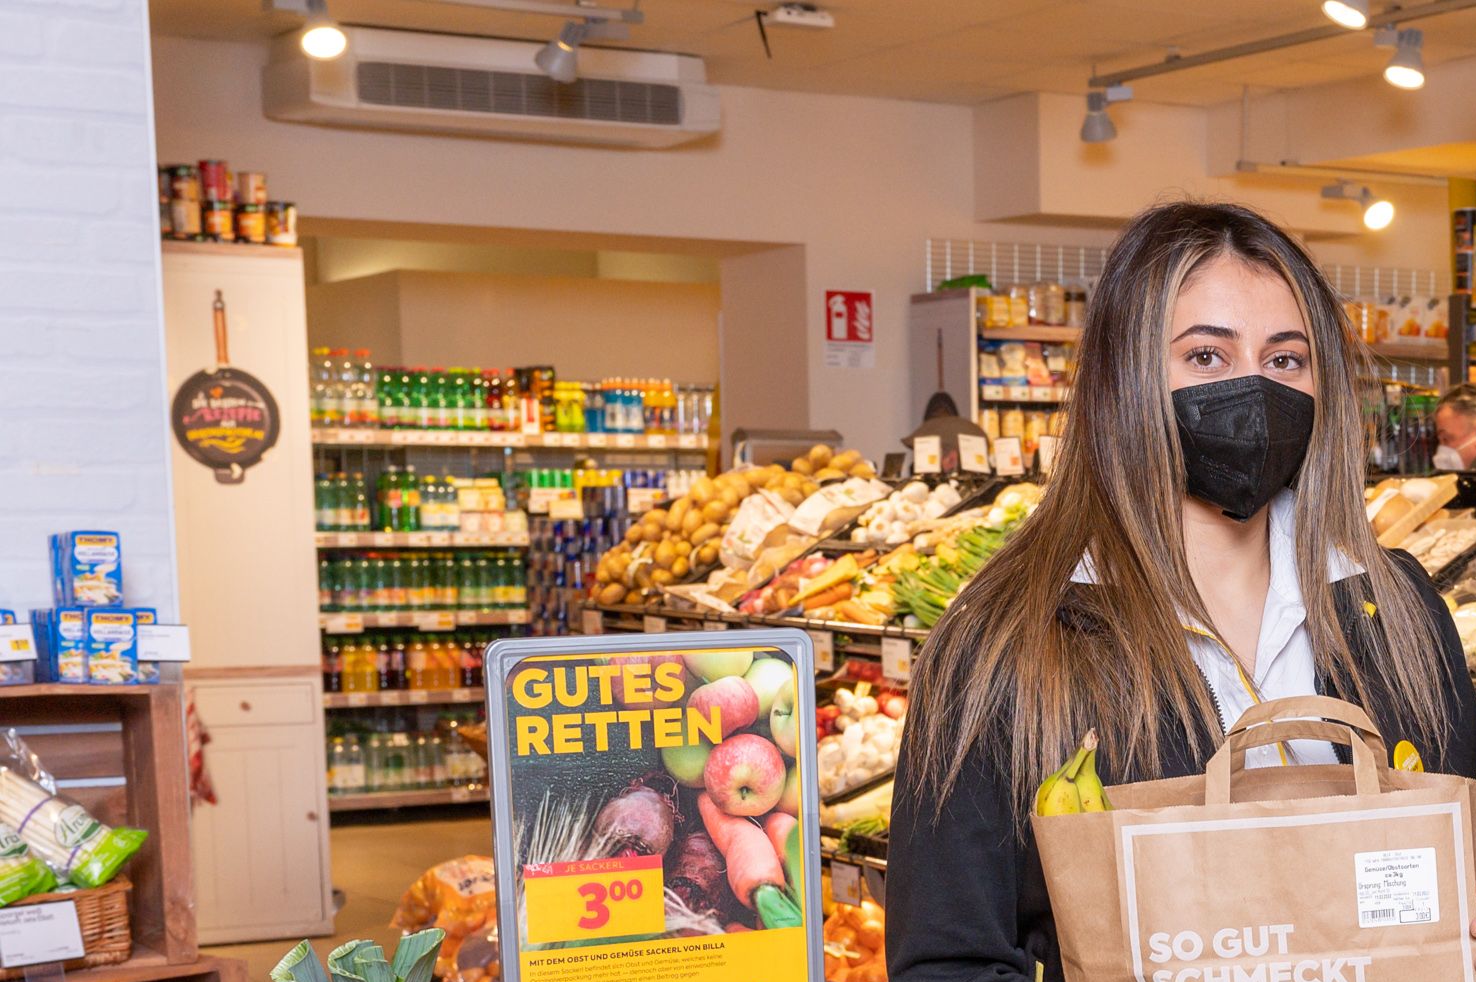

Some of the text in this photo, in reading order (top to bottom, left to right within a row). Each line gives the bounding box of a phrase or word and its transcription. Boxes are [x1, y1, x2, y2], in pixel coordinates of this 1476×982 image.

[63, 613, 84, 621] THO
[512, 662, 685, 709] GUTES
[516, 706, 722, 756] RETTEN
[565, 860, 624, 873] JE SACKERL
[529, 942, 725, 967] MIT DEM OBST UND GEMÜSE SACKERL VON BILLA
[1149, 924, 1294, 963] SO GUT
